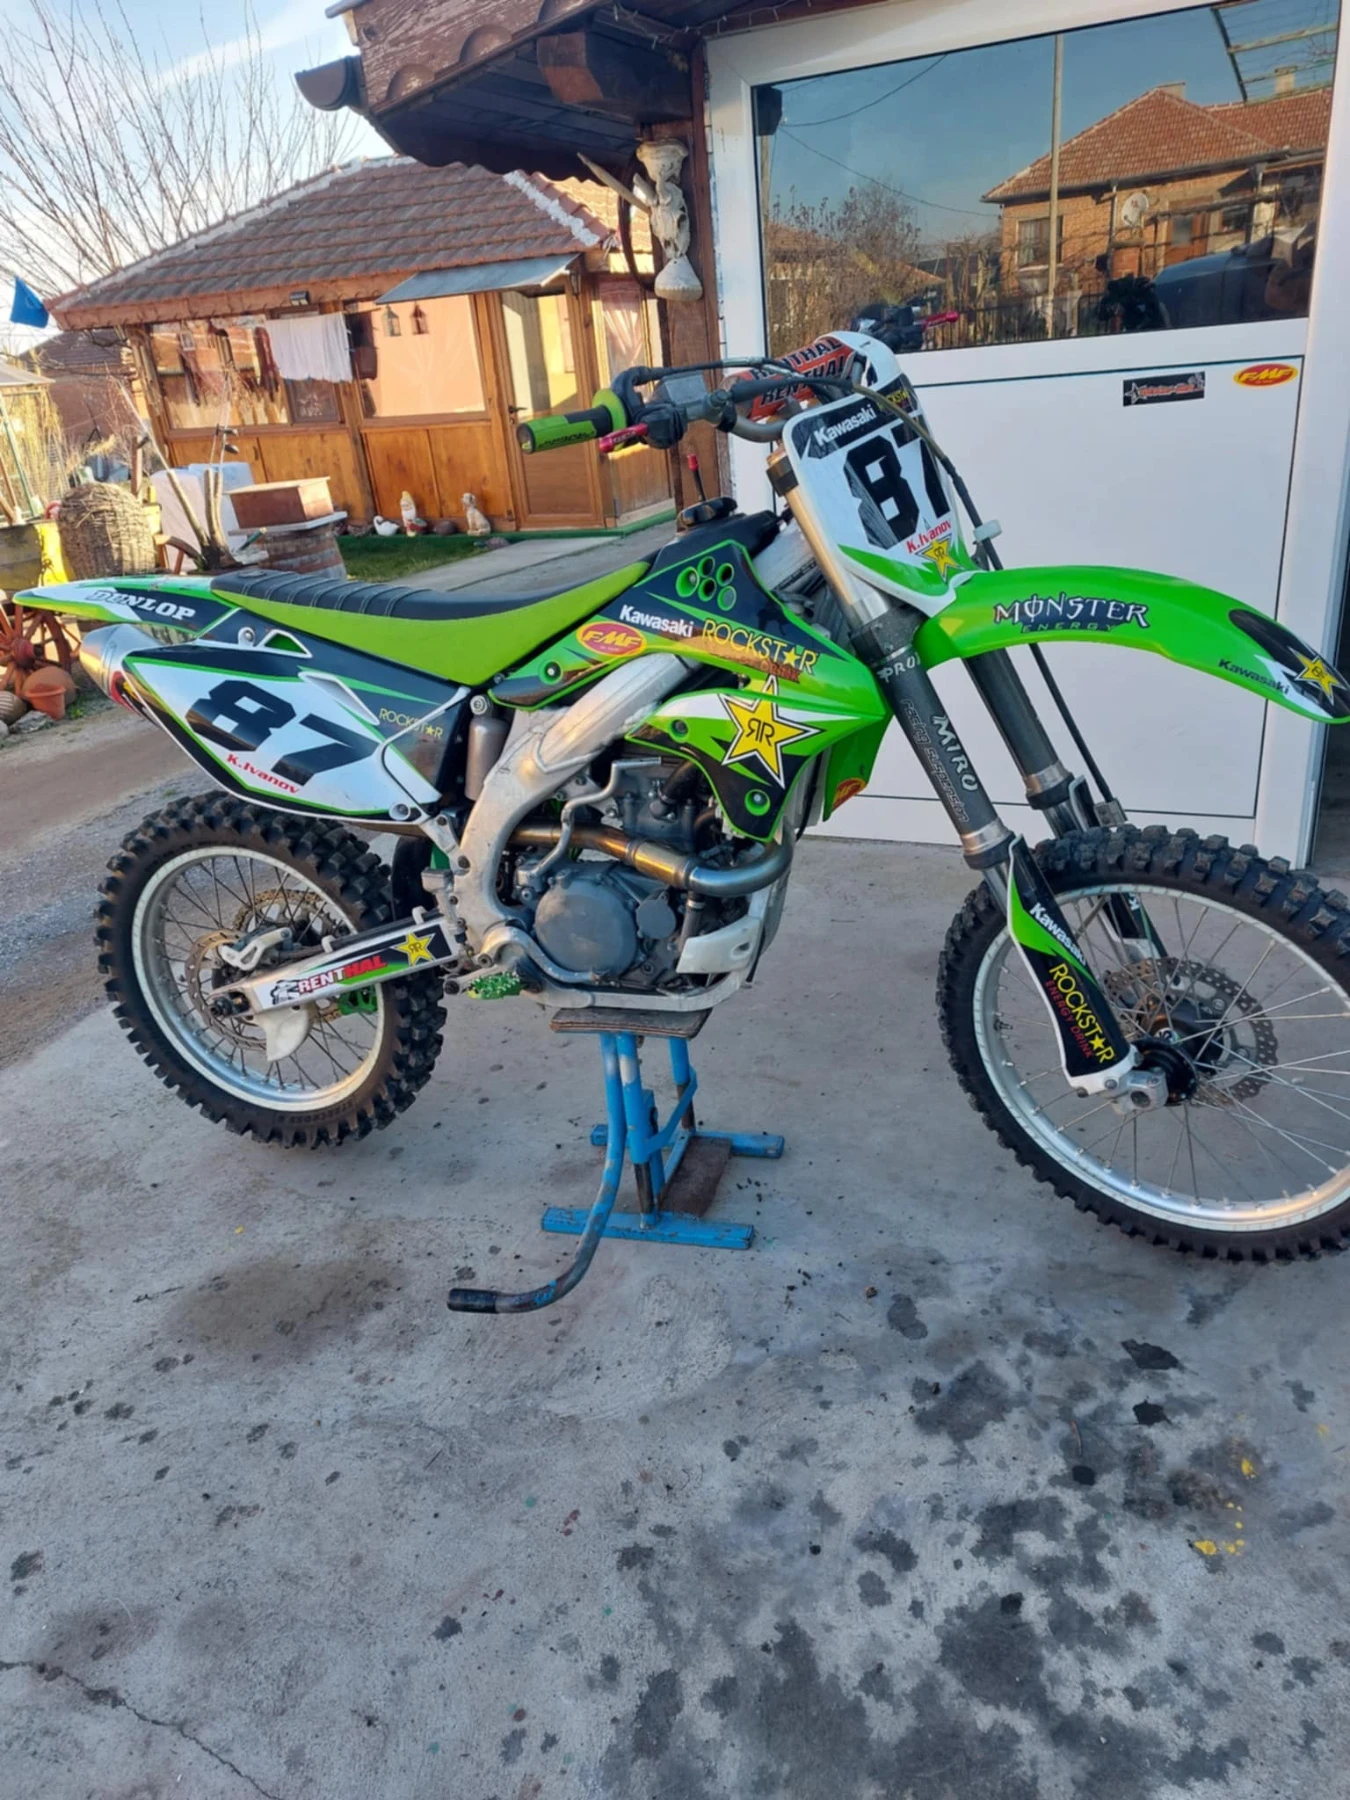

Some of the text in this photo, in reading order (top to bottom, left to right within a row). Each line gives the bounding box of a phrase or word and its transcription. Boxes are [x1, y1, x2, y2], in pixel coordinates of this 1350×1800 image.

[750, 338, 842, 380] RTHAL
[814, 404, 877, 446] Kawasaki
[843, 413, 951, 550] 87
[86, 590, 196, 621] DUNLOP
[620, 604, 694, 638] Kawasaki
[994, 592, 1150, 628] MONSTER
[582, 629, 642, 648] FMF
[1021, 622, 1117, 634] ENERGY
[1218, 658, 1290, 695] Kawasaki
[185, 679, 381, 787] 87
[226, 753, 300, 794] K.Ivanov
[1029, 902, 1087, 967] Kawasaki
[298, 955, 388, 993] RENTHAL
[1044, 979, 1093, 1059] ENERGY DRINK
